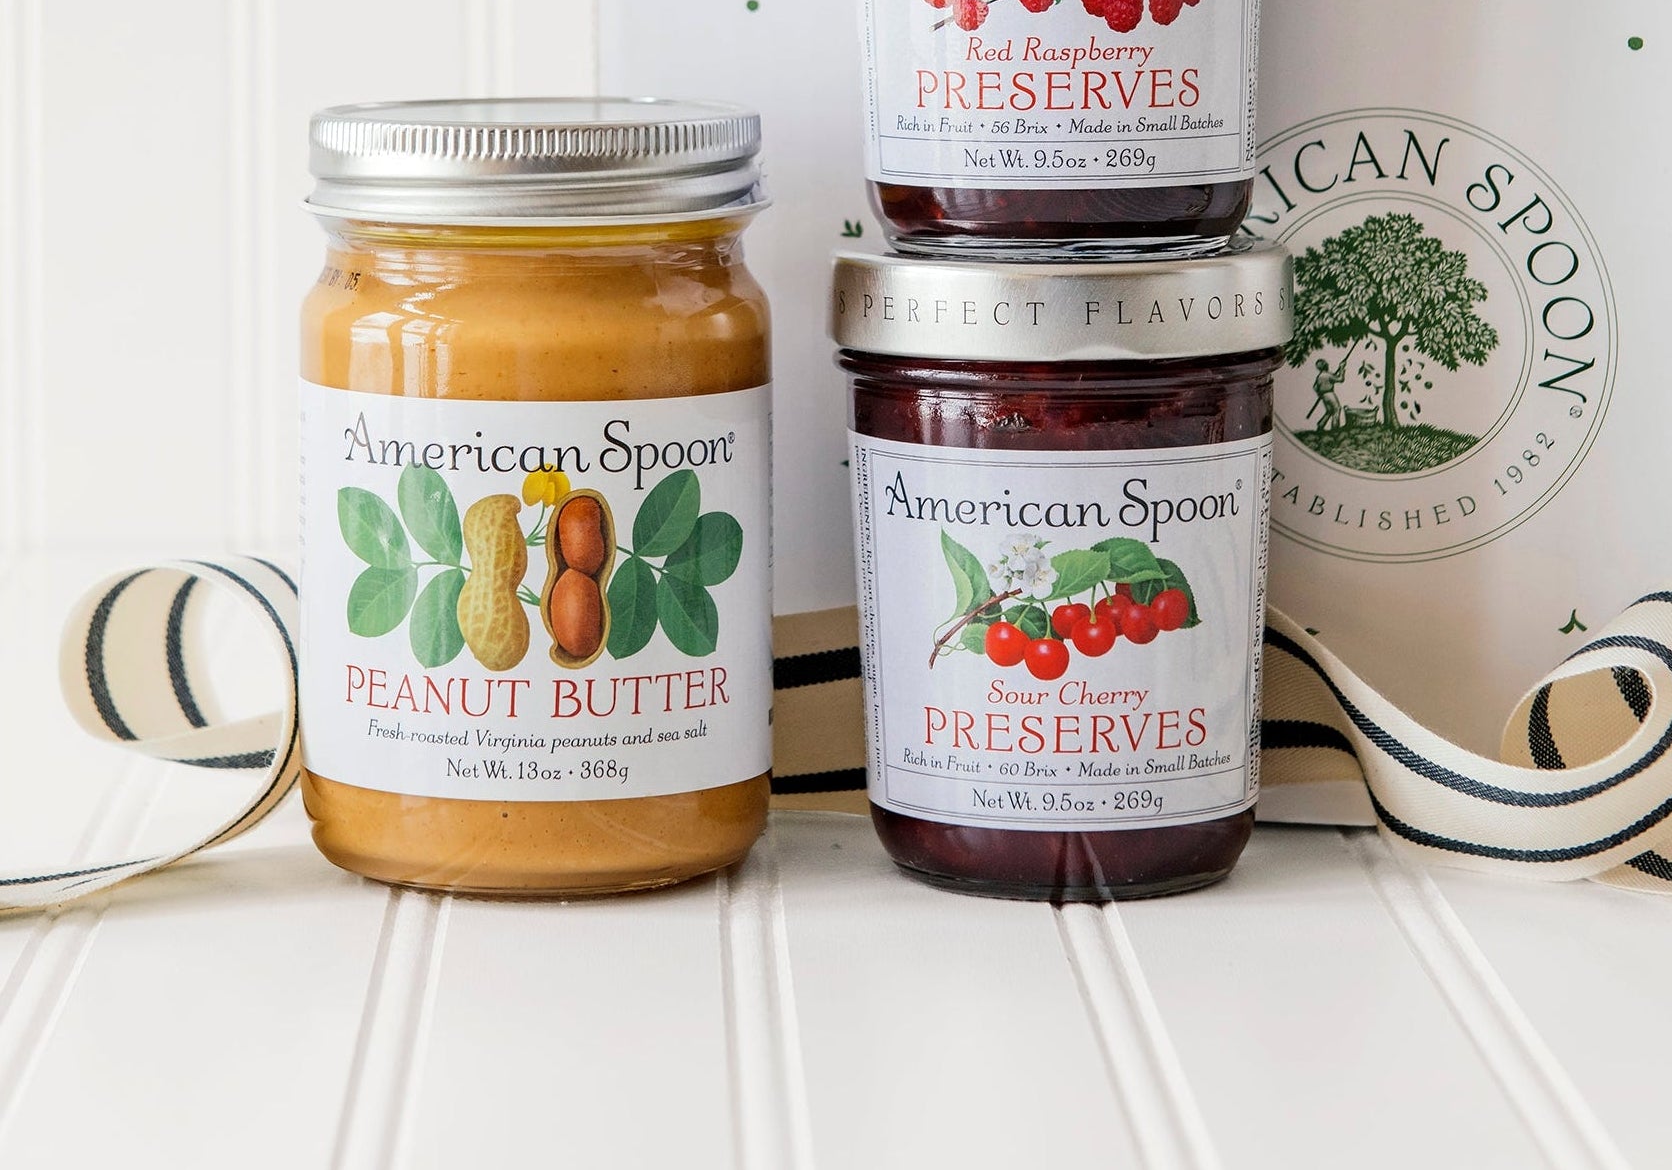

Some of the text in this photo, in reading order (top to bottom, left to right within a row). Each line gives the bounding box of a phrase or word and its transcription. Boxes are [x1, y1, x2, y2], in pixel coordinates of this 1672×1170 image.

[966, 37, 1155, 69] Red Raspberry
[916, 69, 1199, 110] PRESERVES
[897, 114, 1223, 133] Rich in Fruit 56 Brix Made in Small Batches
[964, 148, 1157, 172] Net Wt. 9.5oz 269g
[863, 293, 1045, 326] PERFECT
[1085, 291, 1263, 325] FLAVORS
[344, 411, 591, 474] American
[1494, 432, 1555, 495] 1982
[886, 471, 1110, 528] American
[346, 664, 729, 719] PEANUT BUTTER
[988, 680, 1151, 711] Sour Cherry
[368, 719, 707, 753] Fresh-roasted Virginia peanuts and sea salt
[922, 707, 1208, 754] PRESERVES
[447, 758, 628, 784] Net Wt. 13oz 368g
[904, 748, 1232, 777] Rich in Fruit 60 Brix Made in Small Batches
[973, 789, 1164, 814] Net Wt. 9.5oz 269g
